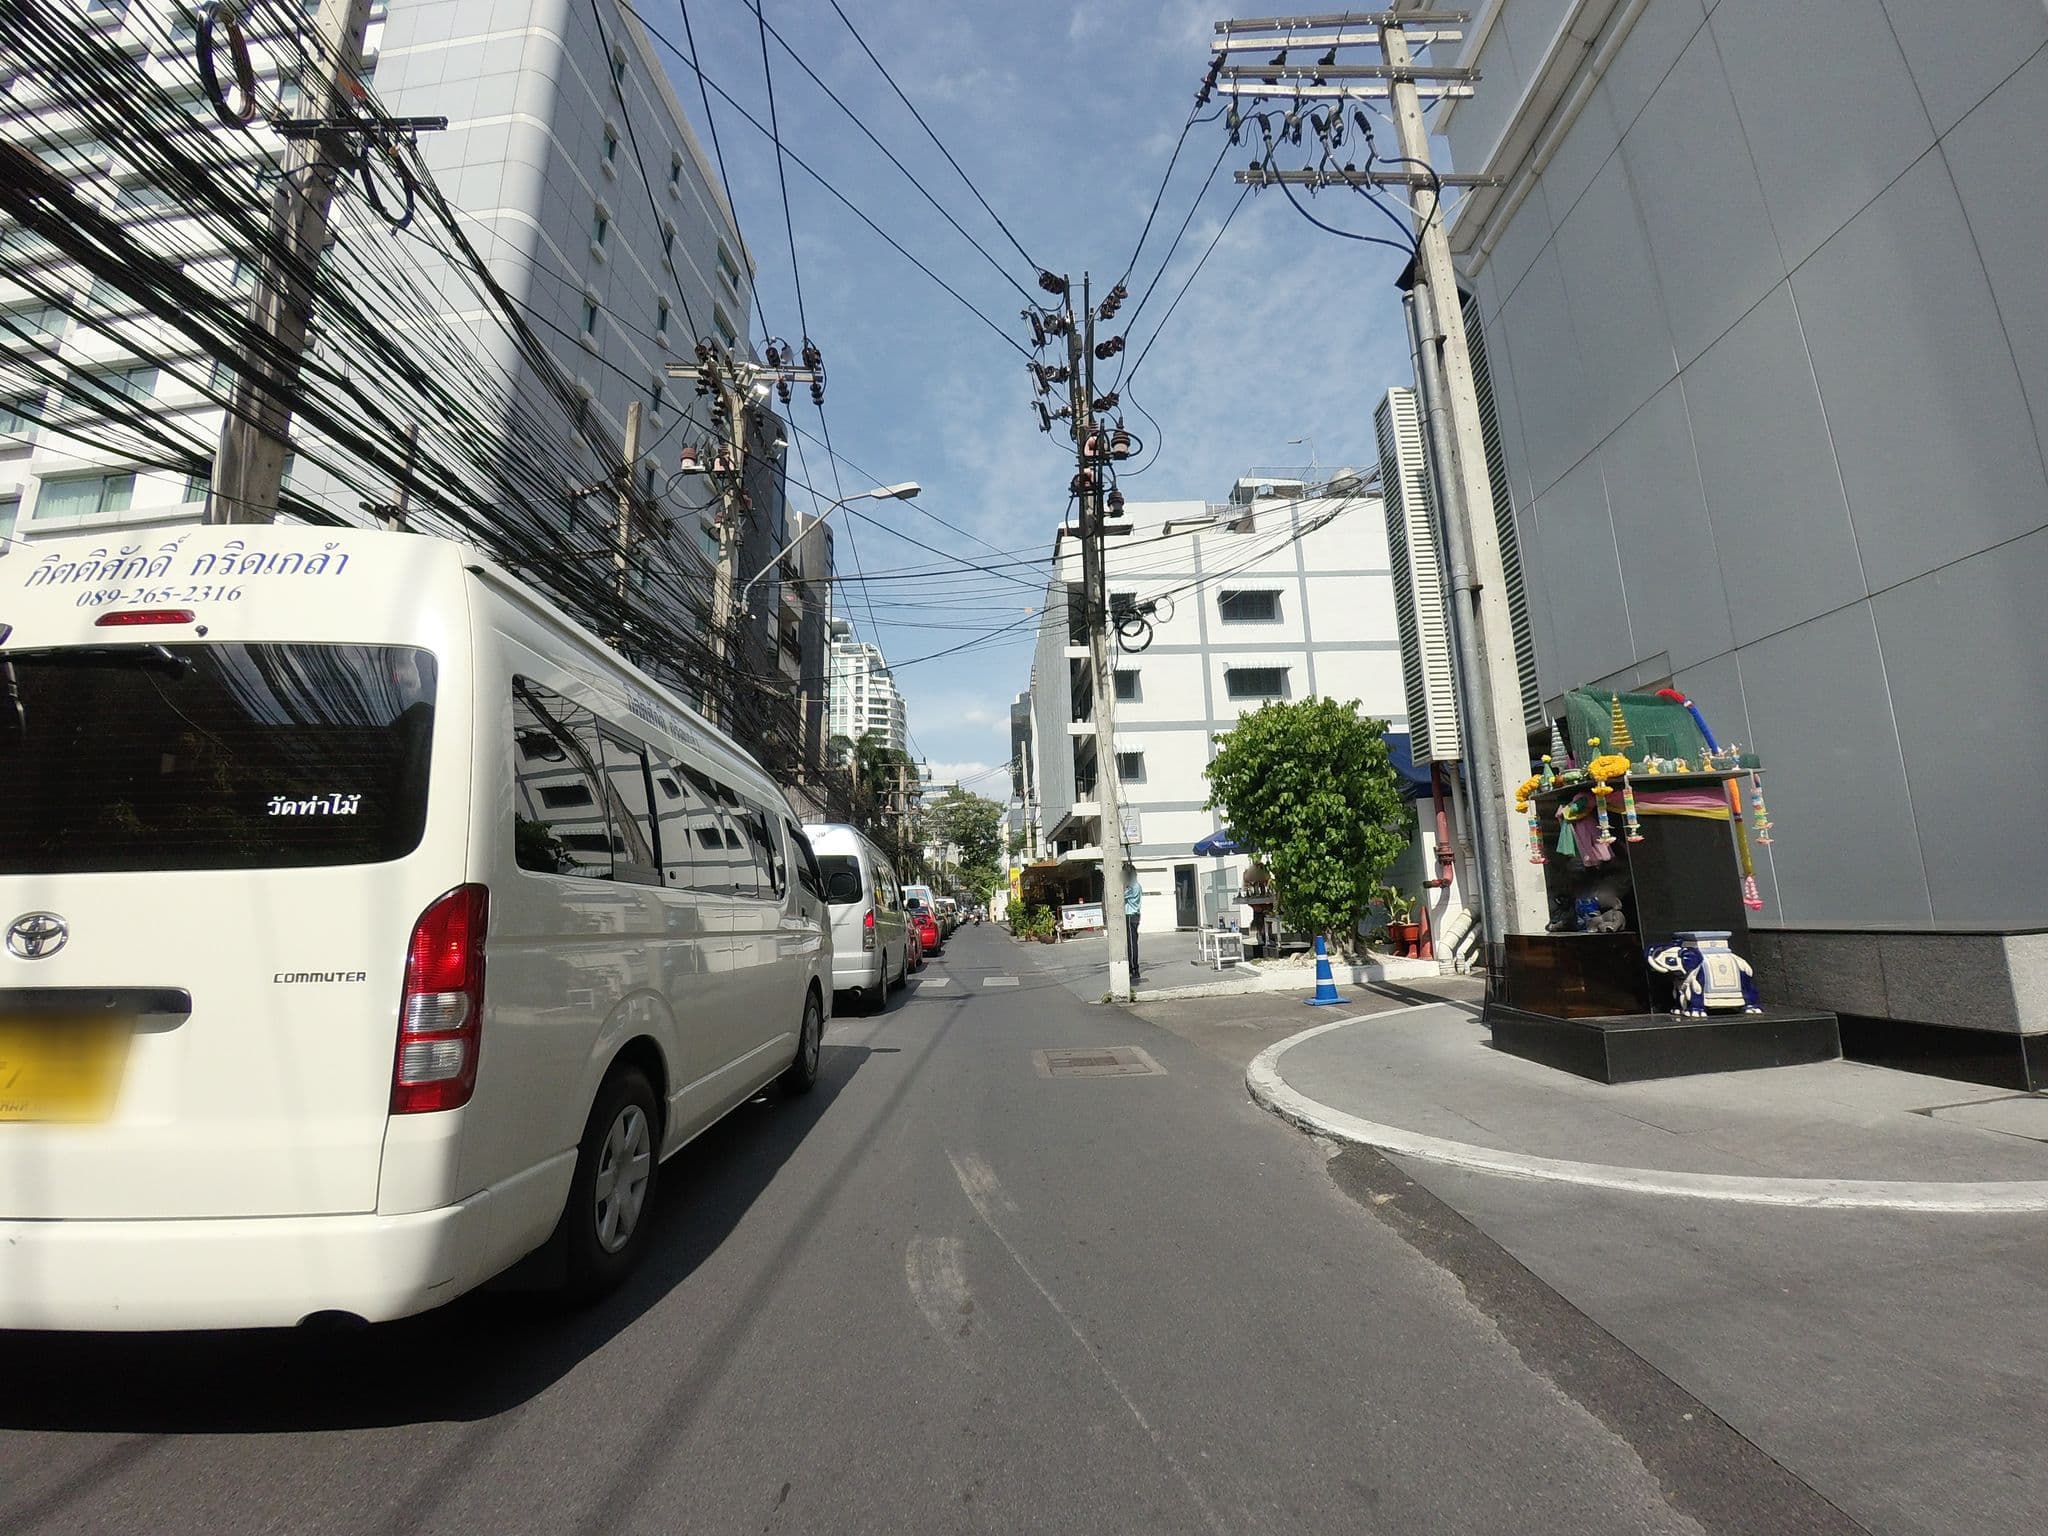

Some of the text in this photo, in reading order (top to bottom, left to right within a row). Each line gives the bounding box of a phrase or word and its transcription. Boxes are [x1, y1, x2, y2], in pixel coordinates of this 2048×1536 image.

[24, 533, 349, 587] กิตติศักดิ์ กริดเกล้า
[76, 585, 244, 607] 089-265-2316
[267, 793, 362, 816] วัดท่าไม้
[273, 971, 366, 983] COMMUTER
